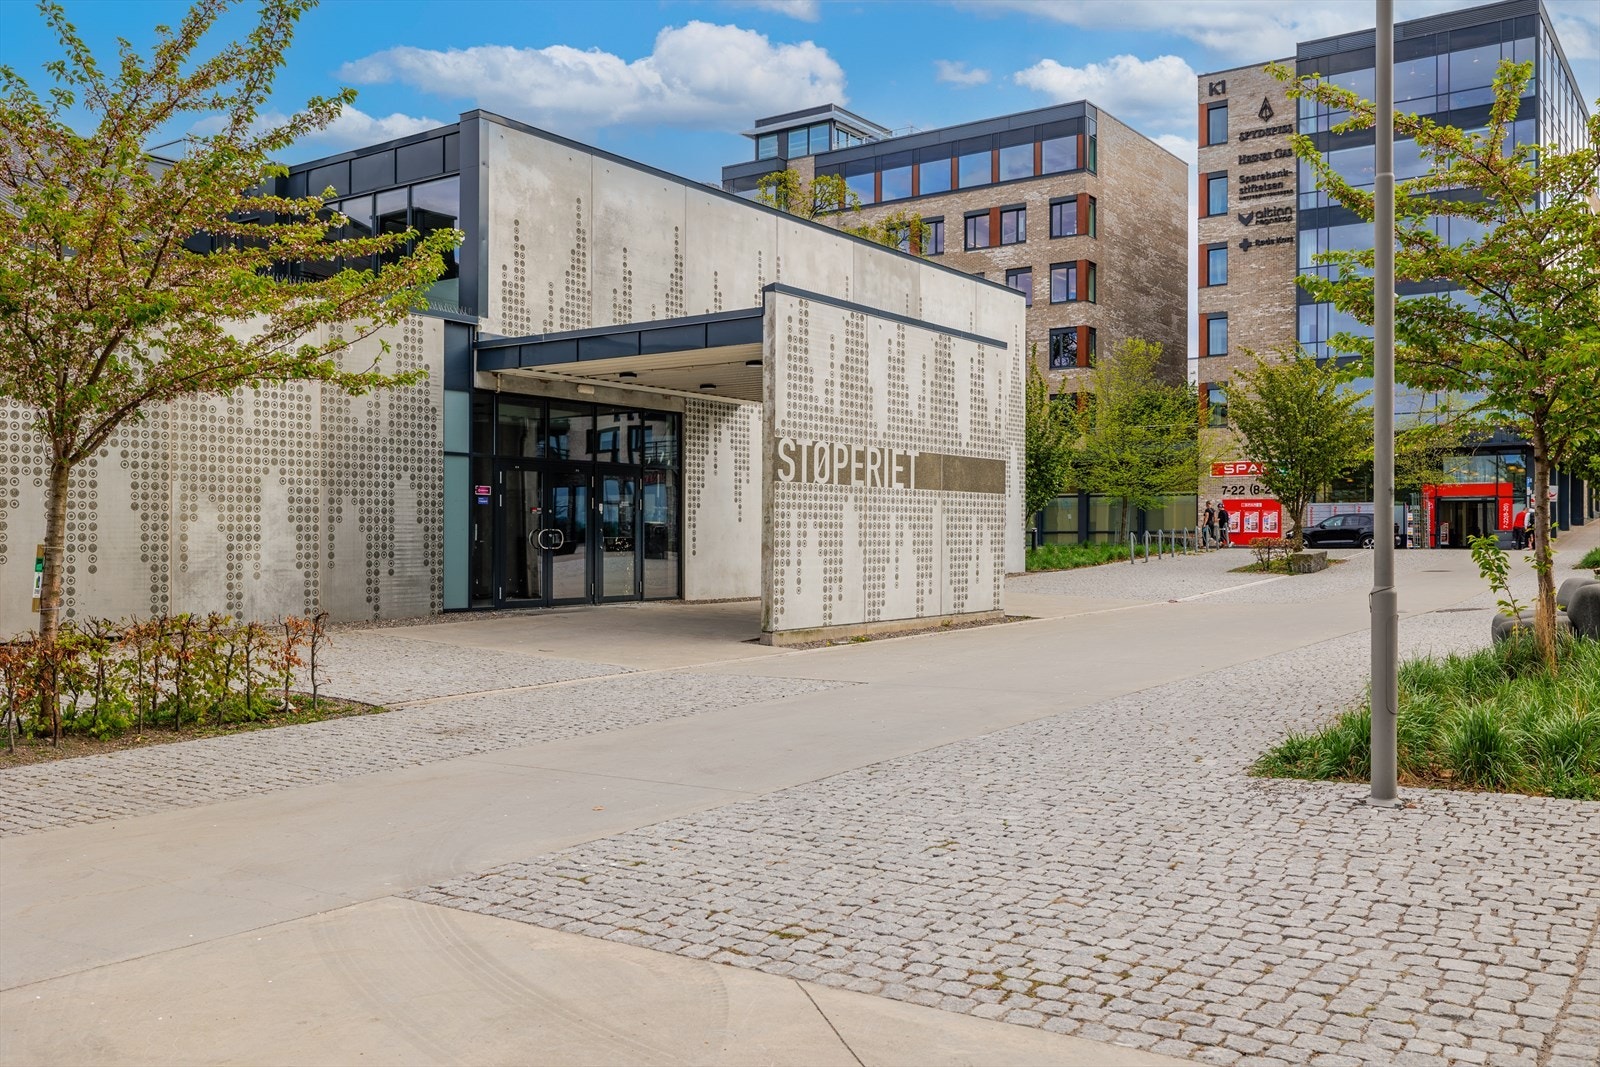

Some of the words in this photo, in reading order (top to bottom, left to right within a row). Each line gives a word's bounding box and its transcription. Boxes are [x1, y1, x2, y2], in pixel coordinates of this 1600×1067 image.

[1239, 169, 1293, 184] Sparebank-
[1239, 182, 1284, 194] stiftelsen
[777, 436, 920, 490] STØPERIET
[1222, 485, 1245, 495] 7-22
[1250, 484, 1272, 496] (8-2
